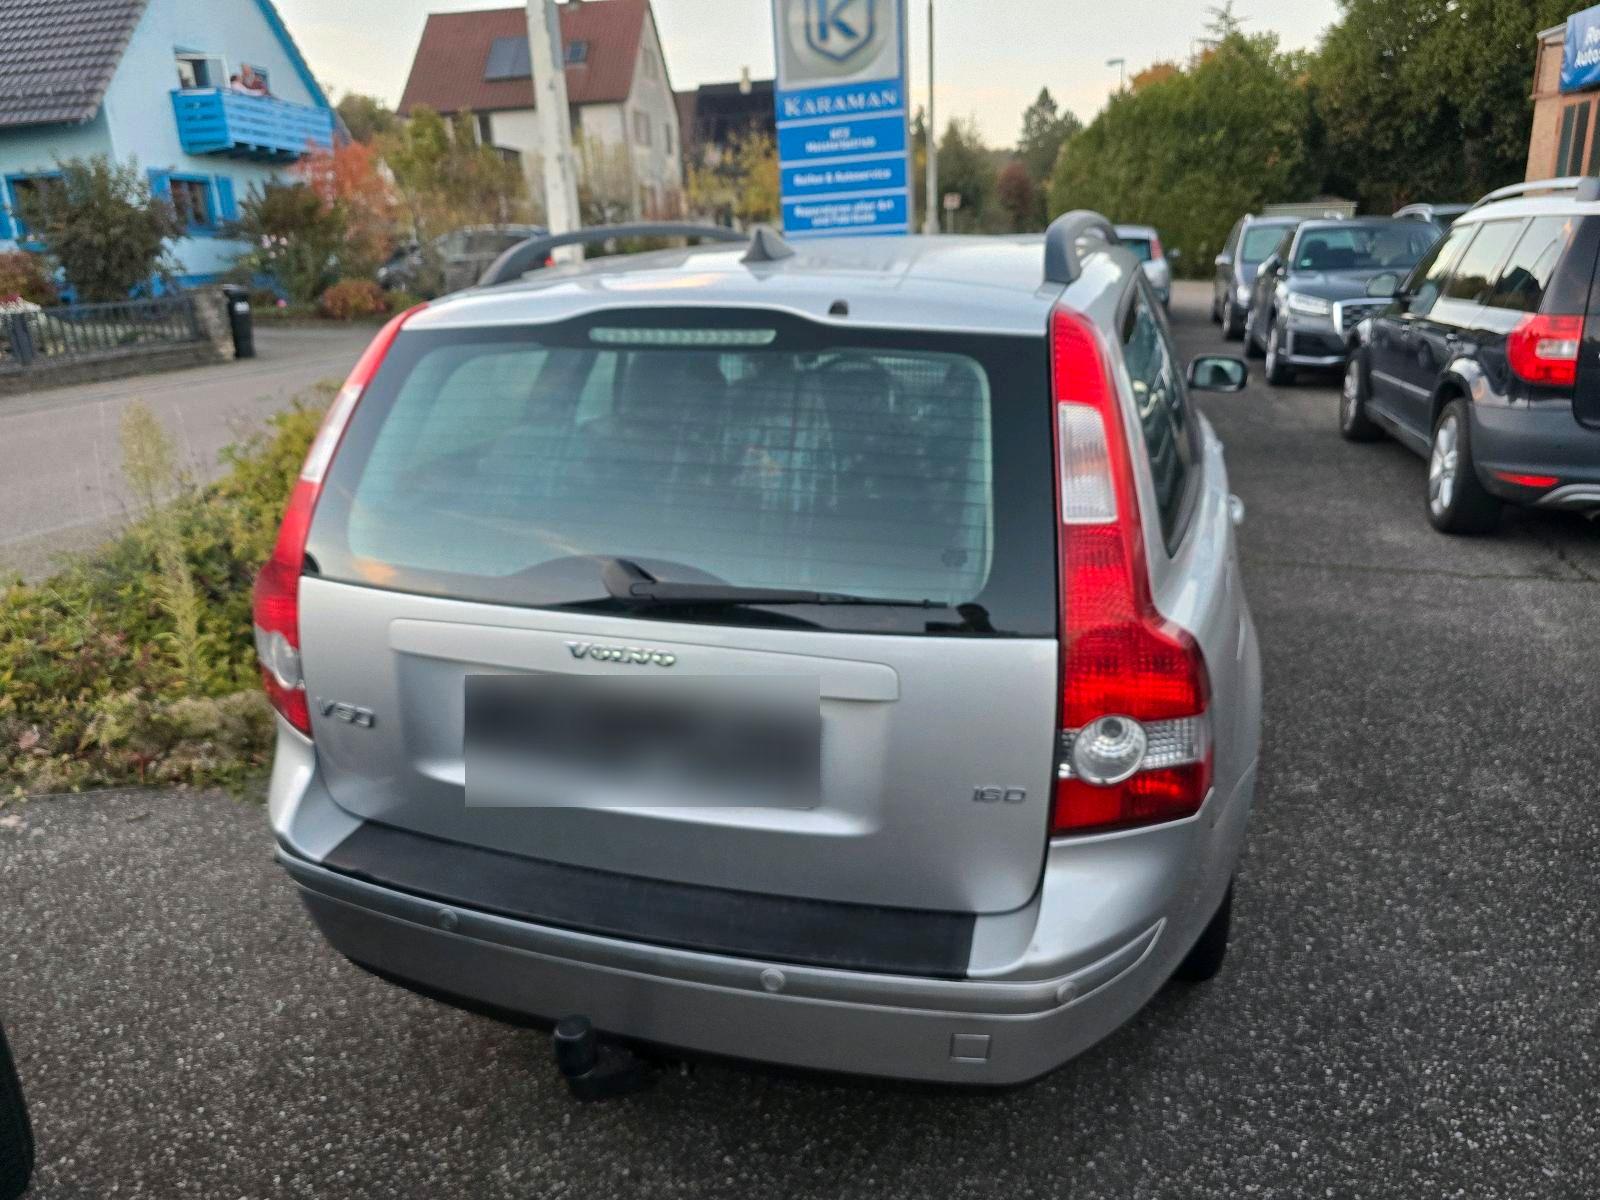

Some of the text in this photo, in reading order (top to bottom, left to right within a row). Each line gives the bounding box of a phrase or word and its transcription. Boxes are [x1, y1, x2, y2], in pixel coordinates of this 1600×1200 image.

[817, 0, 859, 41] K
[783, 89, 897, 117] KARAMAN
[565, 640, 676, 667] VOLVO
[316, 696, 376, 729] V50
